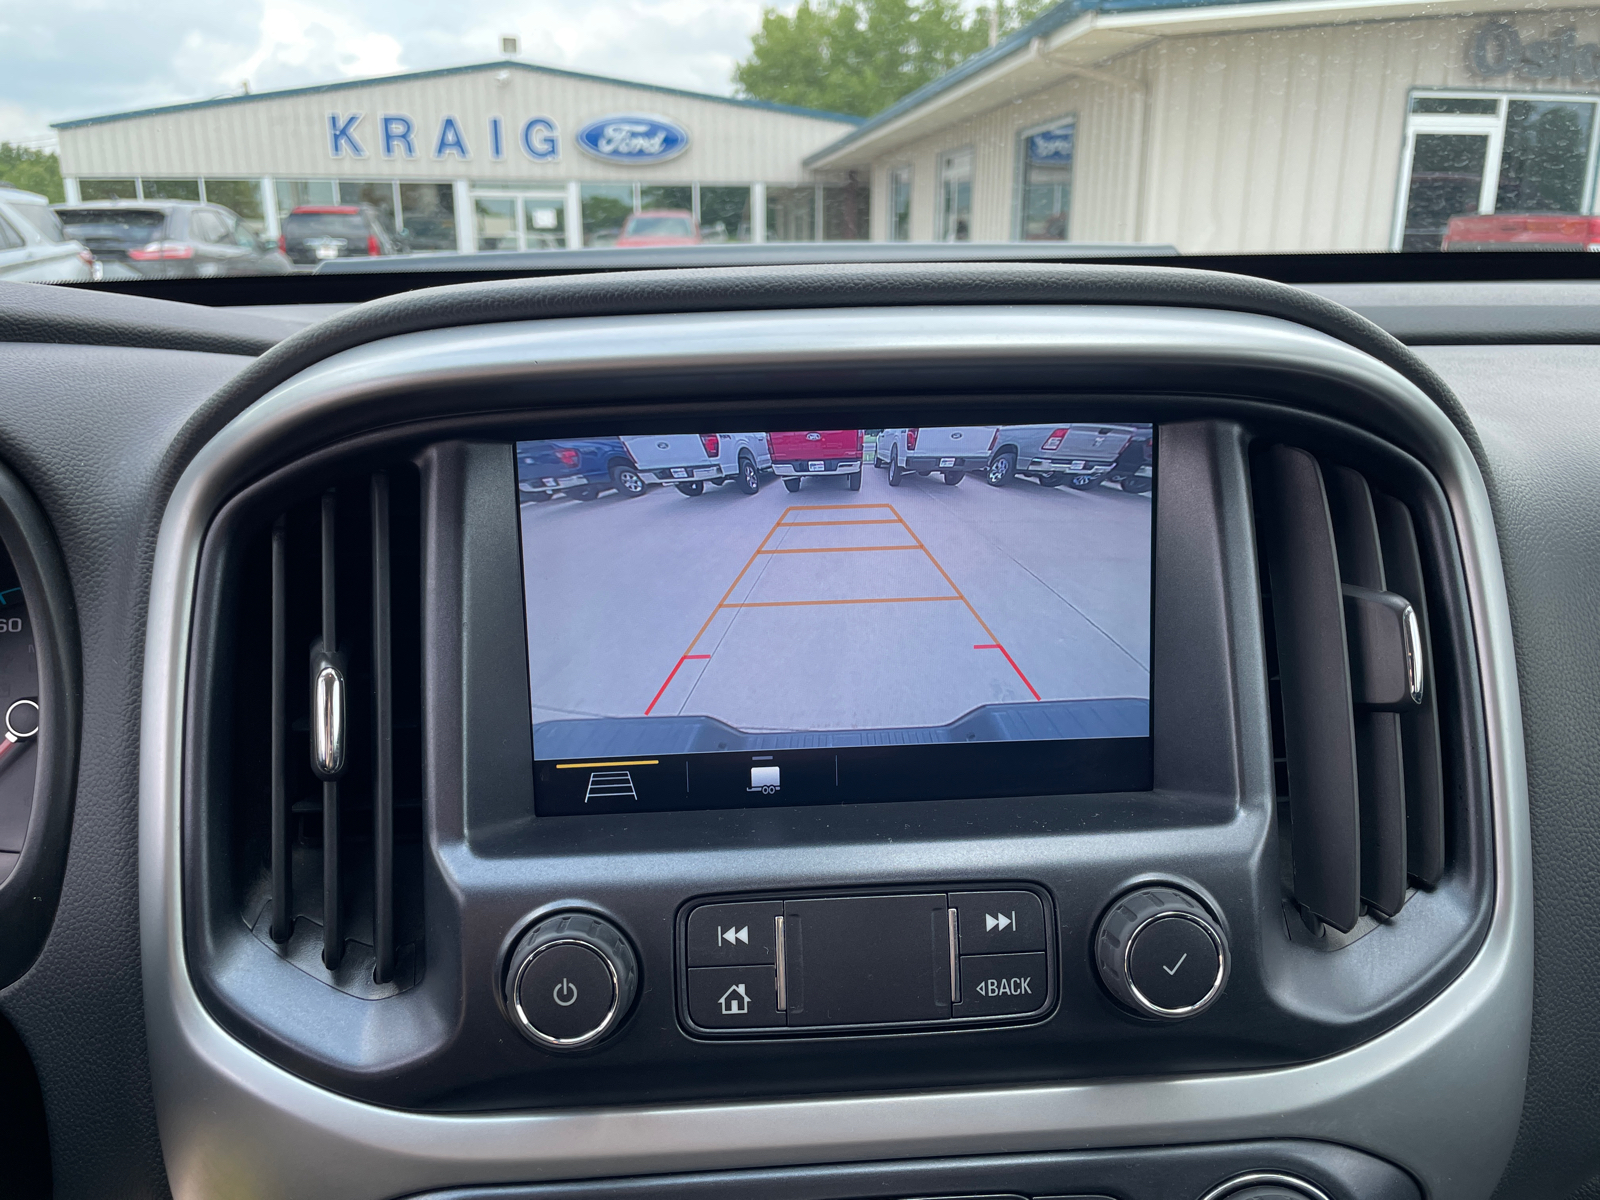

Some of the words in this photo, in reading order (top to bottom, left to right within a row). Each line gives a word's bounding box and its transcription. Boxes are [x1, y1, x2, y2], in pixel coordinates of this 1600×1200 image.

[327, 112, 561, 161] KRAIG
[597, 123, 667, 154] Ford
[987, 976, 1032, 997] BACK
